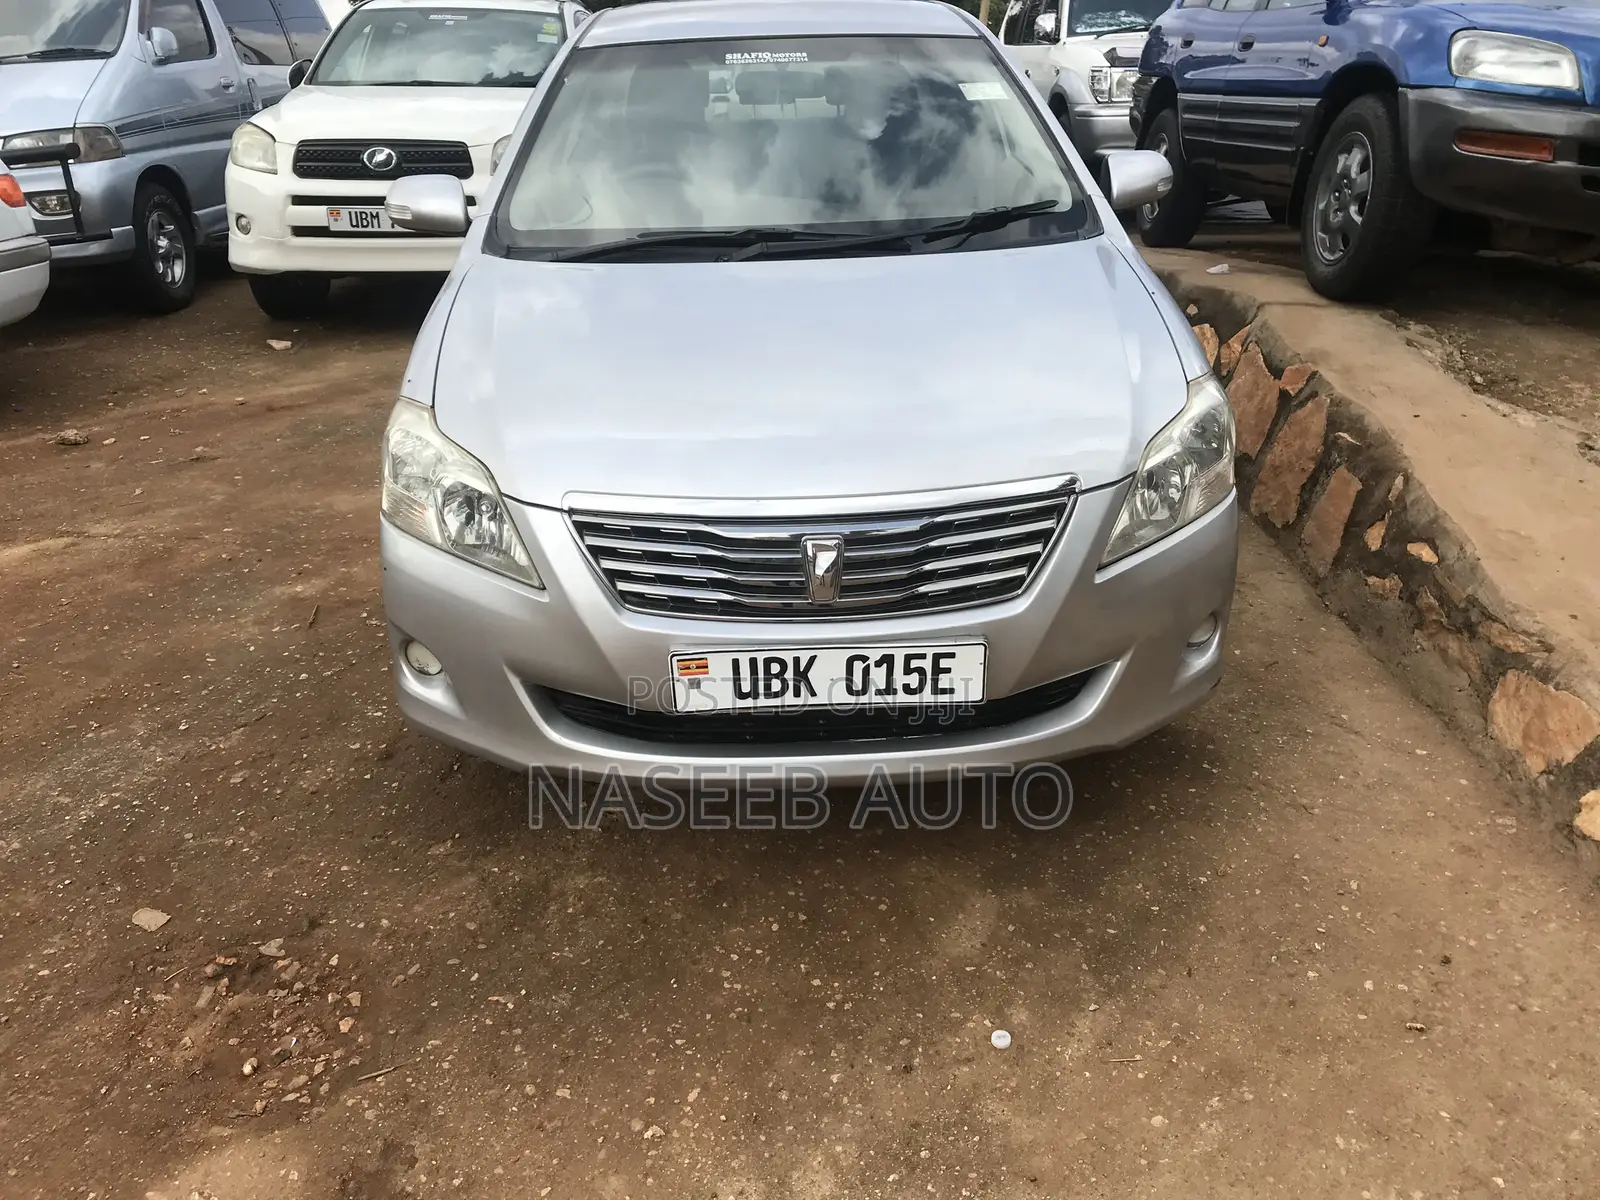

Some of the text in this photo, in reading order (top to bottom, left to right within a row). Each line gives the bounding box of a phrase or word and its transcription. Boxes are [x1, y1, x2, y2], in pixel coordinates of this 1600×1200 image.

[725, 52, 772, 60] SHAFIQ
[348, 210, 381, 229] UBM
[731, 652, 956, 700] UBK 015E
